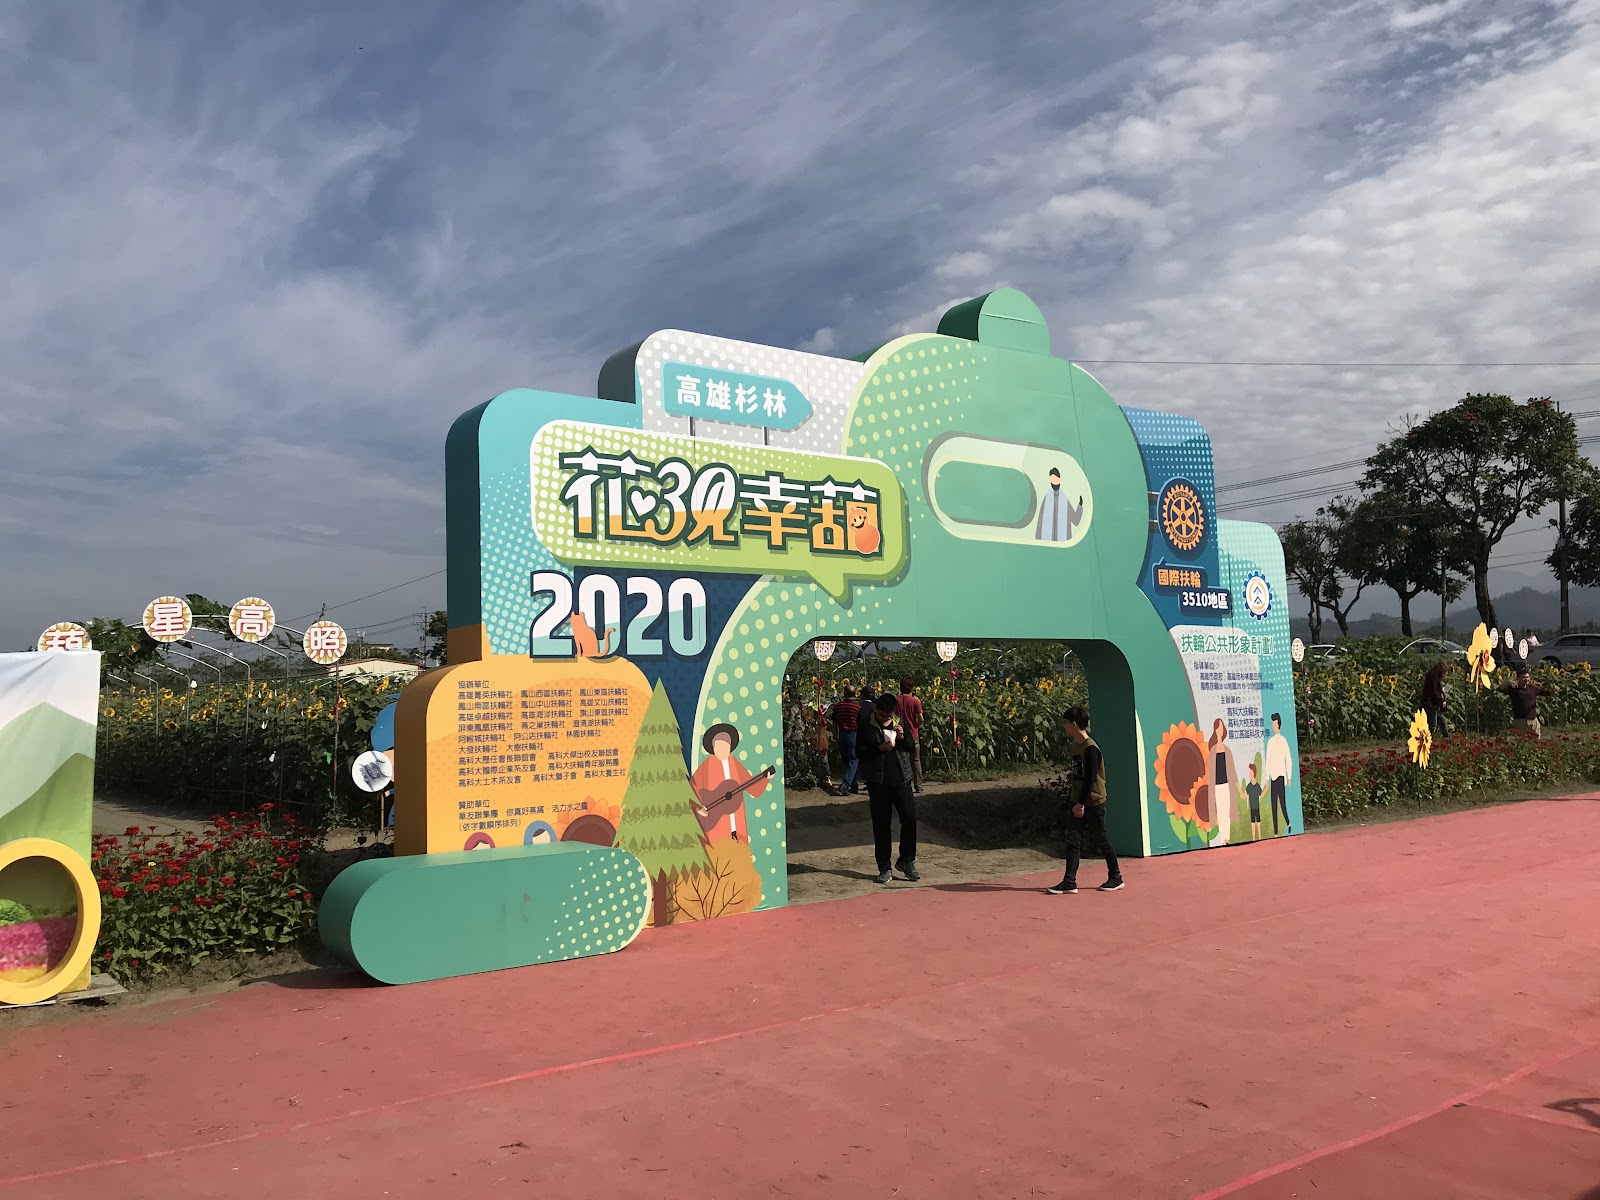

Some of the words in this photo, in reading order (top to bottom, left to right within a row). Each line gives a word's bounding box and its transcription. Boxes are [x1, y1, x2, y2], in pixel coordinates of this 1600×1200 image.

[676, 374, 787, 418] 高雄杉林
[1158, 569, 1201, 588] 國際扶輪
[1182, 591, 1229, 609] 3510地區
[530, 570, 708, 659] 2020
[151, 603, 185, 636] 星
[236, 603, 269, 636] 高
[310, 626, 341, 658] 照
[1181, 634, 1275, 655] 扶輪公共形象計劃
[521, 689, 573, 698] 鳳山西區扶輪社
[580, 688, 628, 697] 鳳山東區扶輪社
[458, 701, 513, 711] 鳳山南區扶輪社
[521, 700, 573, 709] 鳳山中山扶輪社
[580, 698, 628, 707] 高雄文山扶輪社
[521, 710, 573, 719] 高雄海洋扶輪社
[513, 731, 559, 741] 阿公店扶輪社
[458, 744, 498, 755] 大發扶輪社
